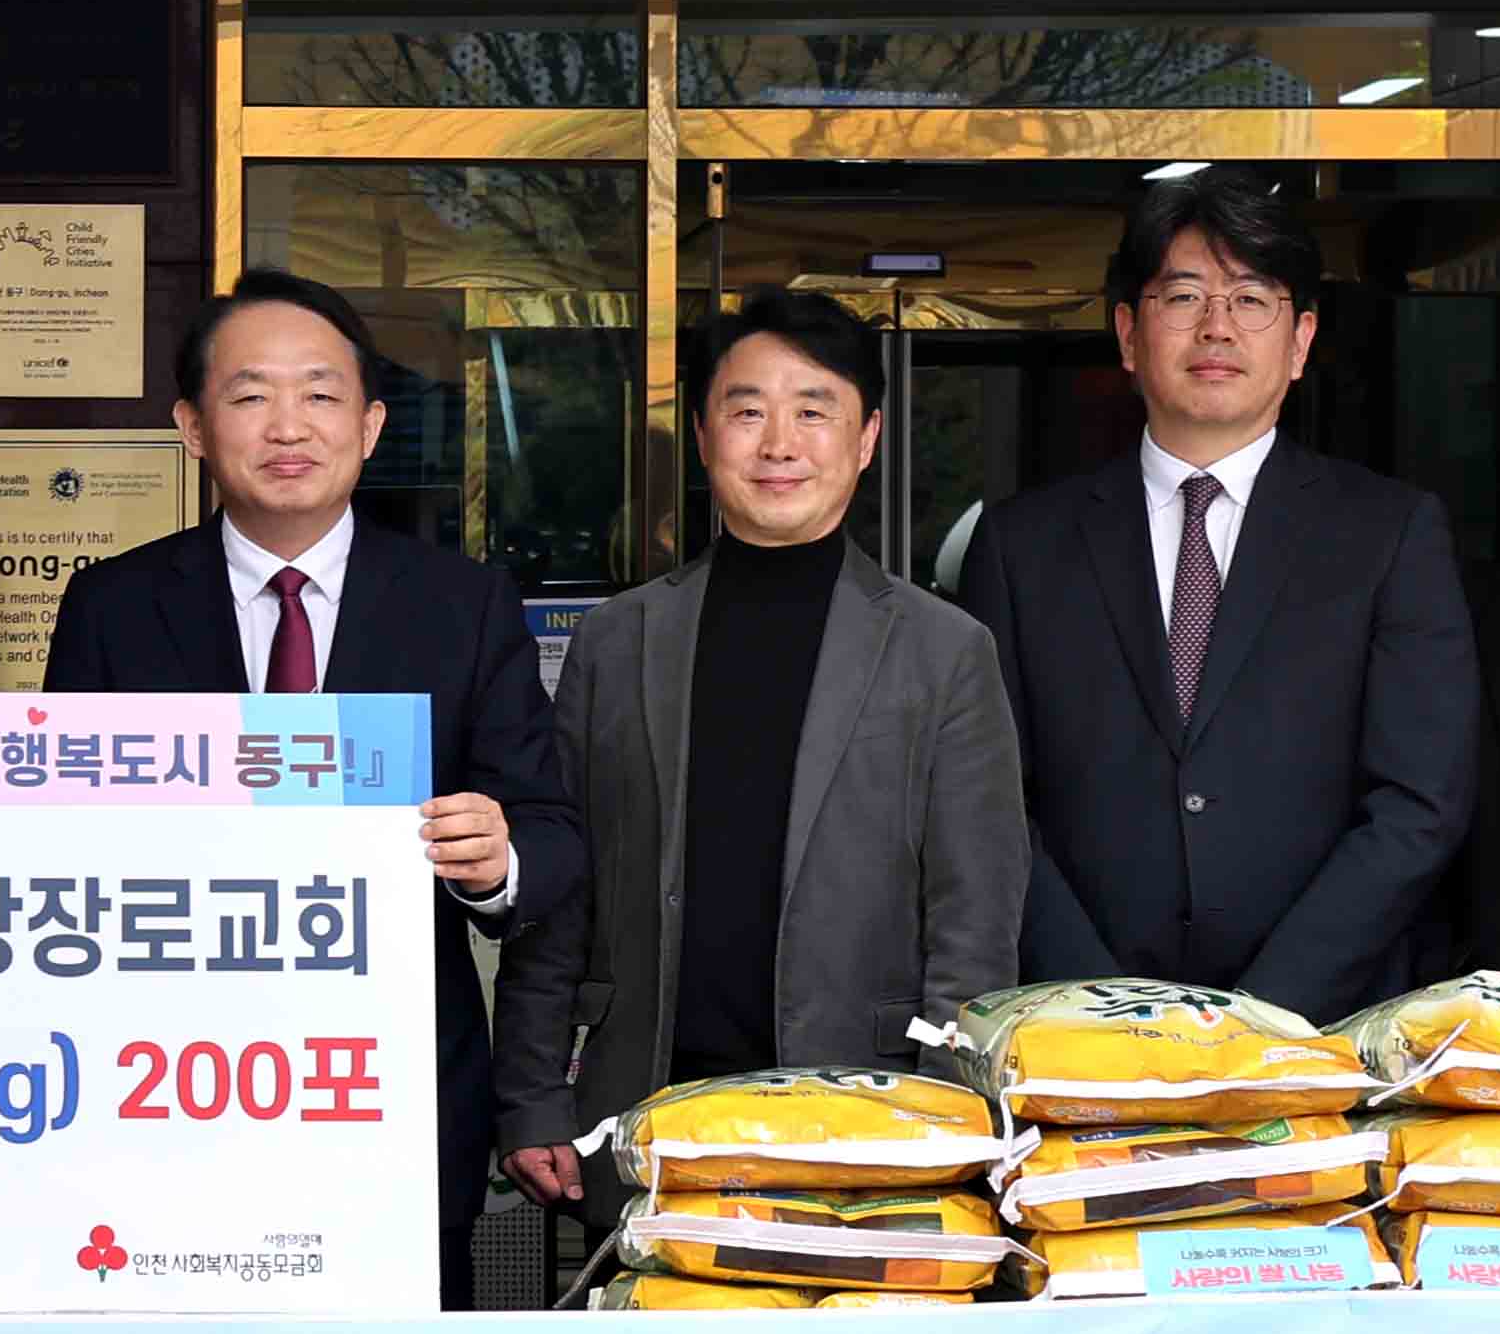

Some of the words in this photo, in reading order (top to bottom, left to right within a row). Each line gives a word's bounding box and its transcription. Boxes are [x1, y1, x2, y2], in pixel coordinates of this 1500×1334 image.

[66, 222, 93, 233] Child
[66, 234, 108, 246] Friendly
[66, 247, 95, 256] Cities
[66, 259, 112, 267] Initiative
[7, 531, 18, 544] is
[22, 531, 36, 544] to
[39, 531, 84, 546] certify
[87, 531, 114, 544] that
[7, 649, 33, 662] and
[1, 732, 209, 787] 행복도시
[117, 1037, 383, 1122] 200포
[133, 1253, 167, 1275] 인천
[173, 1253, 323, 1282] 사회복지공동모금회
[1170, 1264, 1254, 1288] 사랑의
[1258, 1265, 1286, 1284] 쌀
[1289, 1262, 1345, 1283] 나눔
